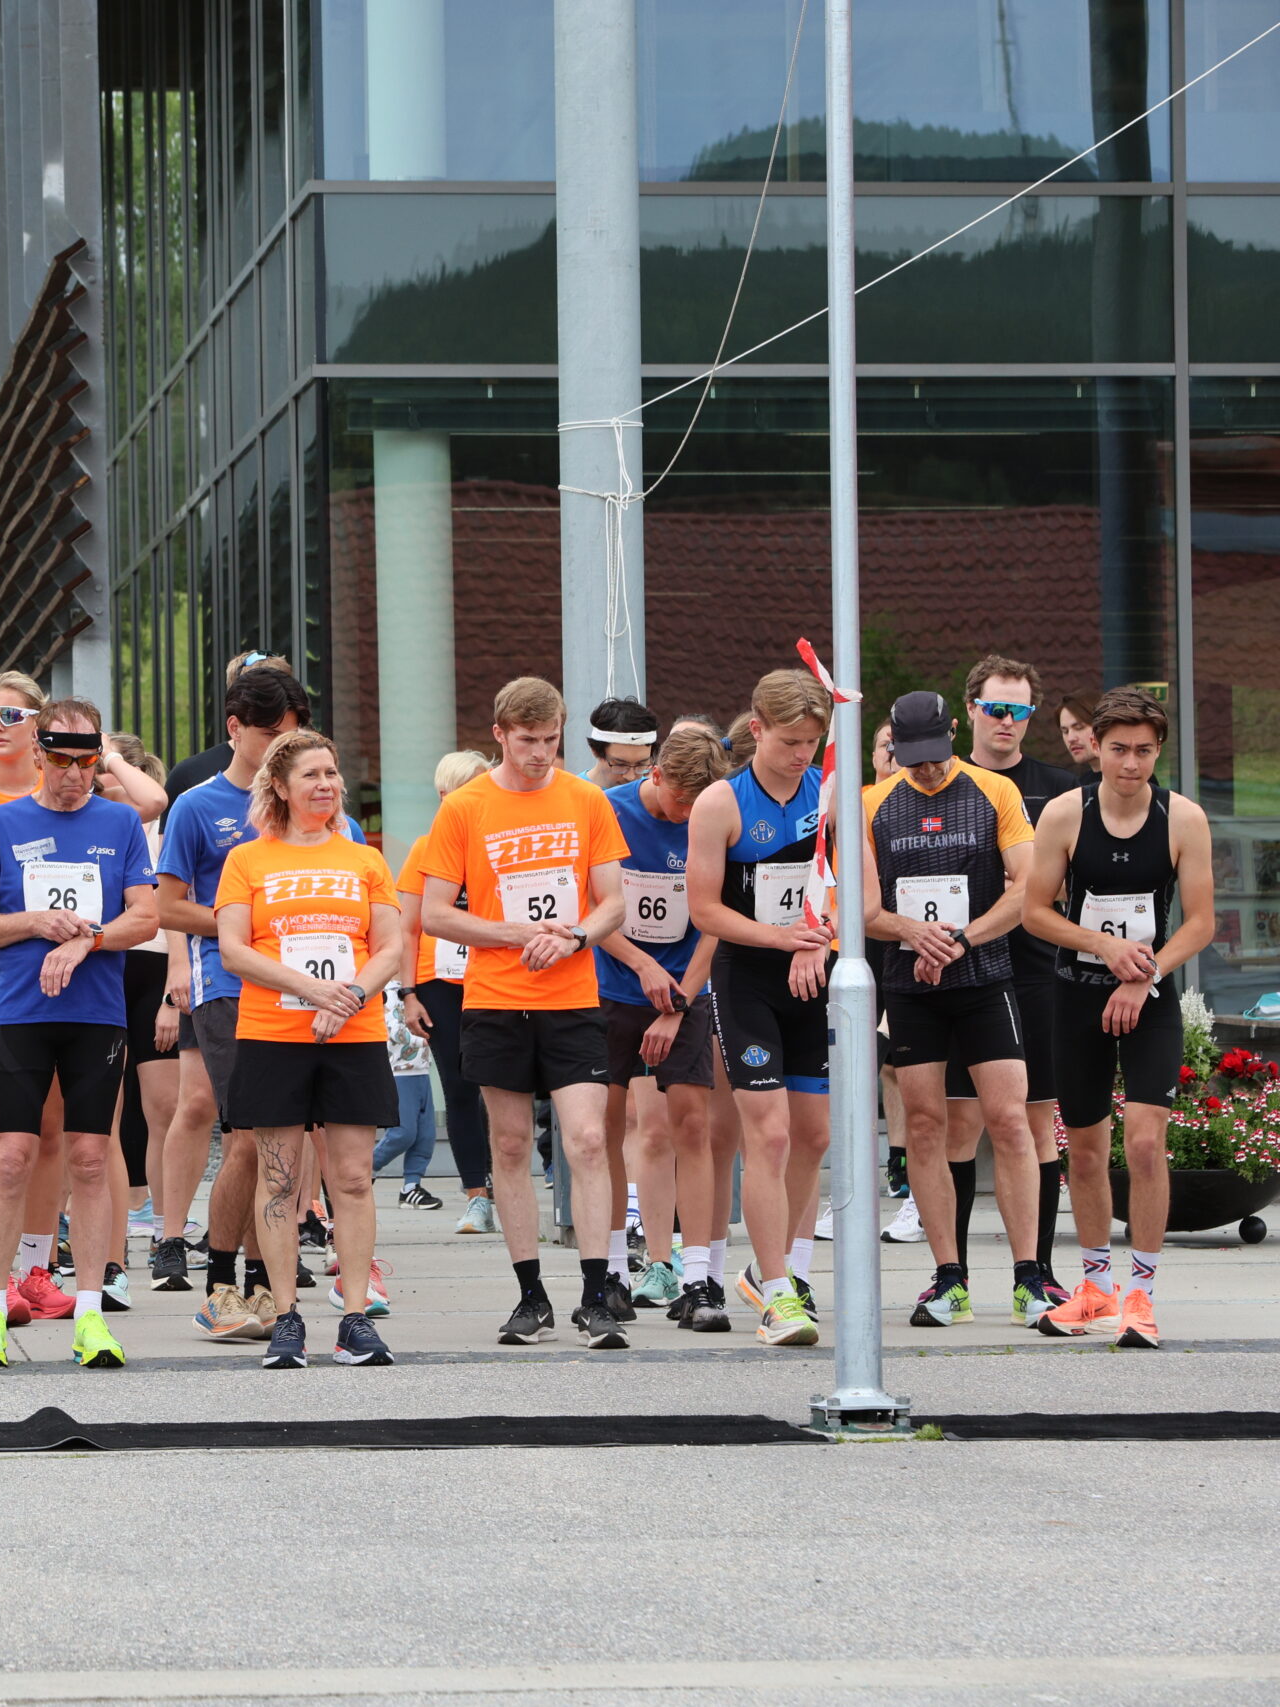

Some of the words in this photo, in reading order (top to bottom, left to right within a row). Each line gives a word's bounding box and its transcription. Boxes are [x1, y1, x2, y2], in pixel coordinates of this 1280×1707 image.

[484, 822, 576, 841] SENTRUMSGATELØPET
[890, 832, 977, 852] HYTTEPLANMILA
[96, 847, 116, 856] asics
[490, 832, 577, 867] 2024
[48, 888, 77, 912] 26
[267, 876, 360, 904] 2024
[780, 886, 804, 910] 41
[528, 894, 558, 922] 52
[638, 896, 667, 921] 66
[924, 901, 938, 922] 8
[289, 913, 361, 926] KONGSVINGER
[1101, 920, 1127, 939] 61
[456, 944, 468, 959] 4
[305, 959, 335, 981] 30
[1080, 970, 1119, 985] TEC
